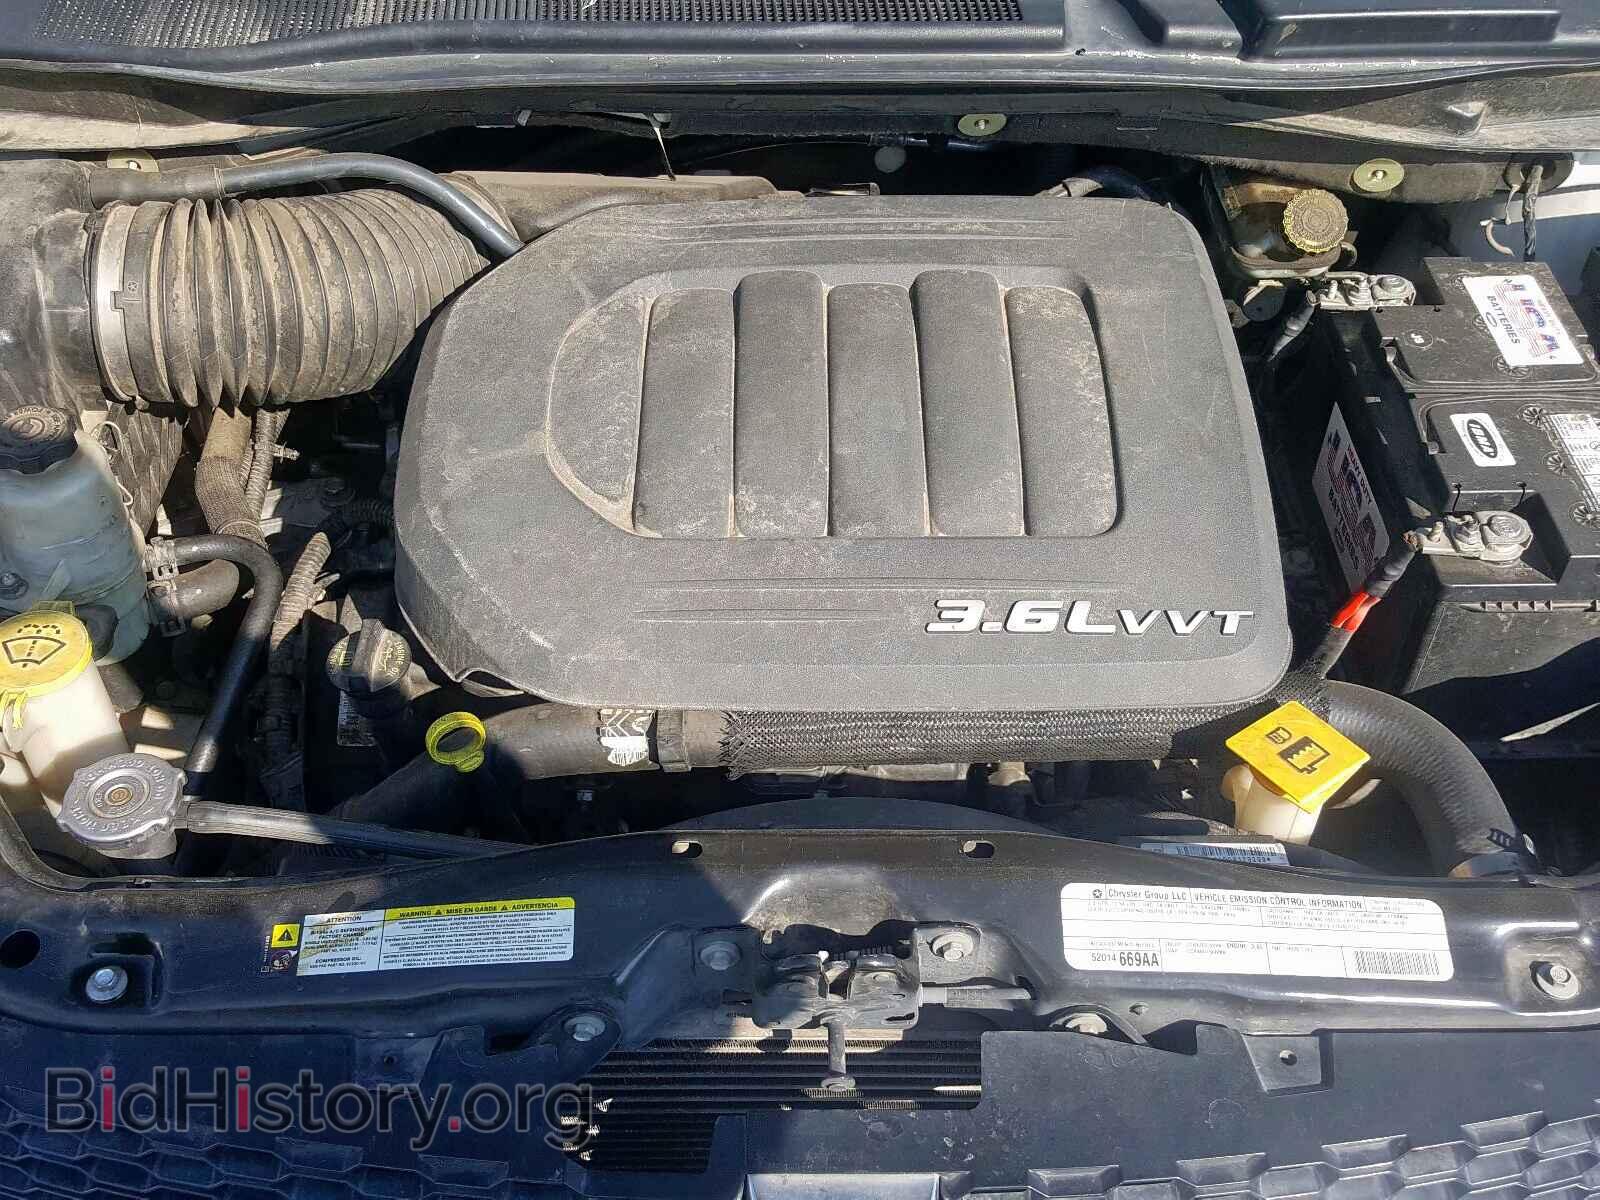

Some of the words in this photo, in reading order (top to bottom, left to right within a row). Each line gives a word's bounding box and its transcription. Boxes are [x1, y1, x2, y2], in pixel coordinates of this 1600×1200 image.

[1485, 295, 1522, 343] BATTERIES
[1108, 888, 1142, 899] Chrysler
[1144, 890, 1169, 900] Group
[1172, 891, 1187, 900] LLC
[1195, 892, 1226, 902] VEHICLE
[1229, 894, 1267, 904] EMISSION
[1270, 896, 1304, 906] CONTROL
[1308, 897, 1362, 909] INFORMATION
[400, 910, 432, 918] WARNING
[511, 902, 558, 911] ADVERTENCIA
[1091, 952, 1117, 961] 52014
[1119, 951, 1160, 966] 669AA
